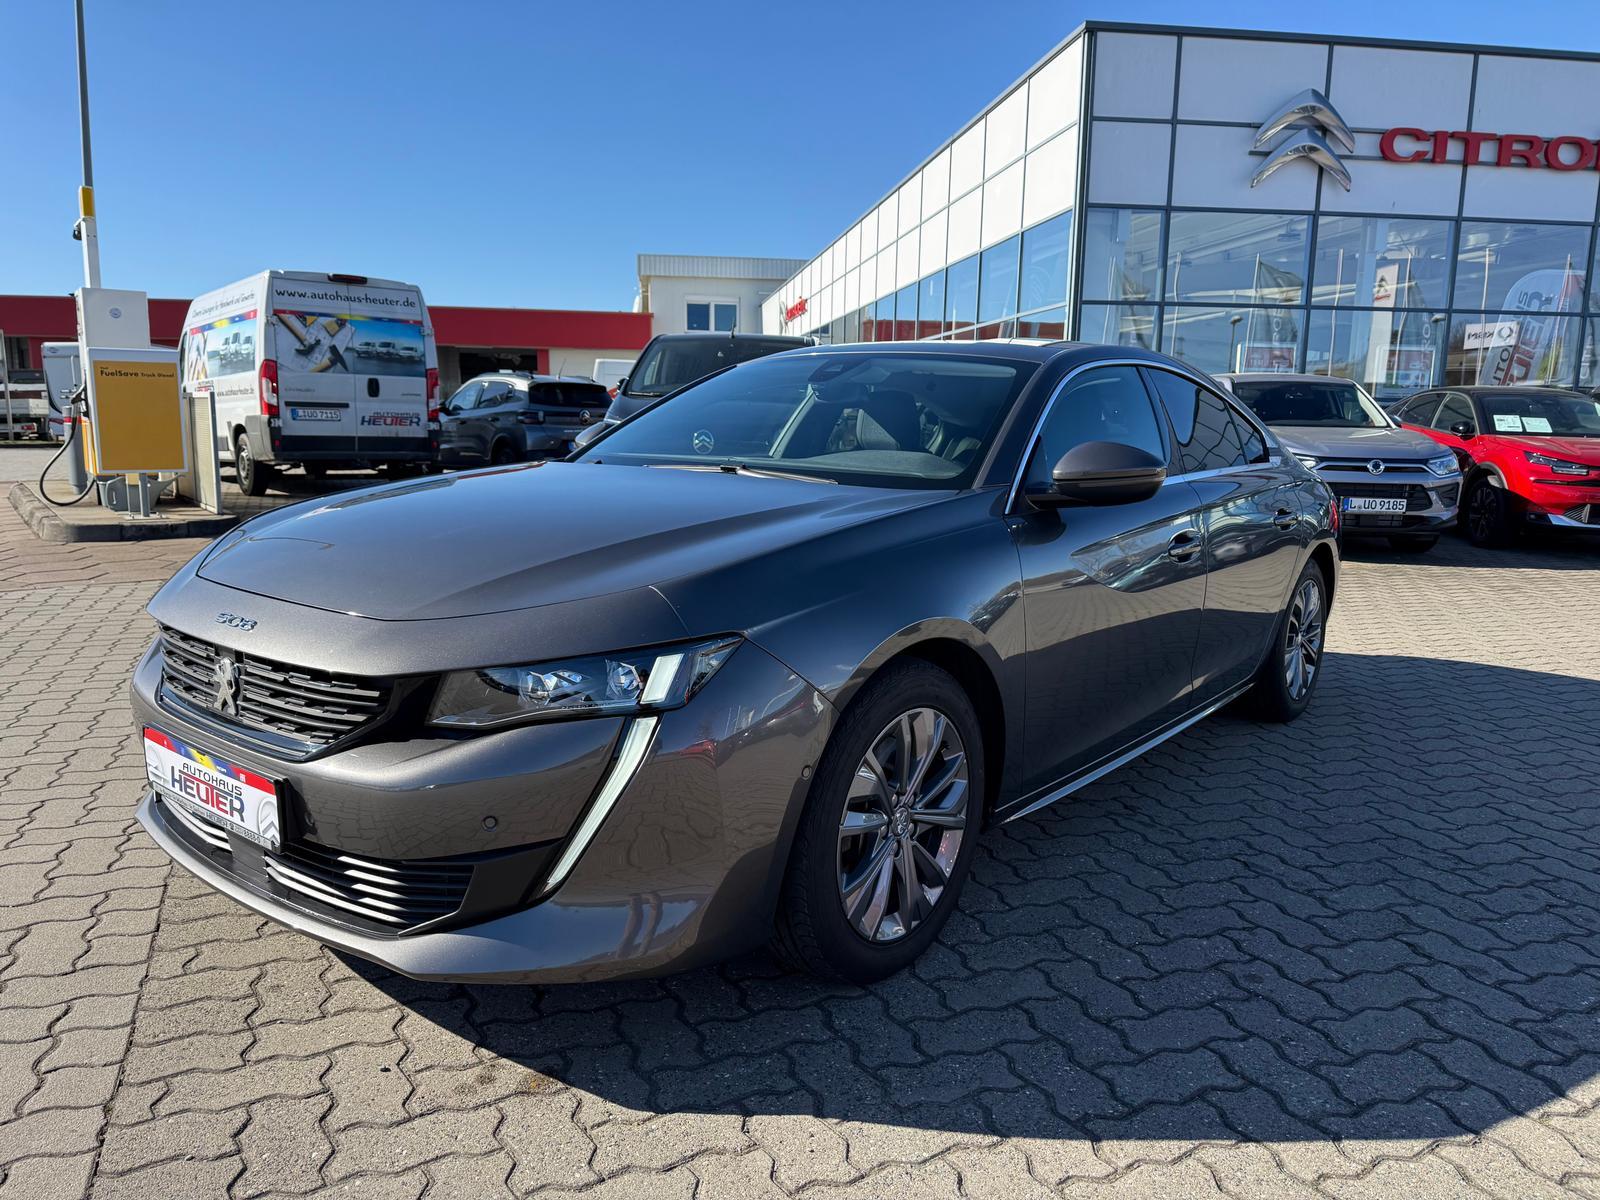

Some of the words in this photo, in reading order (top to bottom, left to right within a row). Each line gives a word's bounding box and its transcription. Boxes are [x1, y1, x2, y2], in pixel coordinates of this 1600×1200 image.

[1379, 127, 1600, 171] CITRO
[275, 289, 416, 308] www.autohaus-heuter.de
[360, 415, 421, 427] HEUTER
[1379, 501, 1405, 511] 9185
[215, 612, 258, 632] 508
[182, 762, 243, 797] AUTOHAUS
[170, 765, 245, 823] HEUTER
